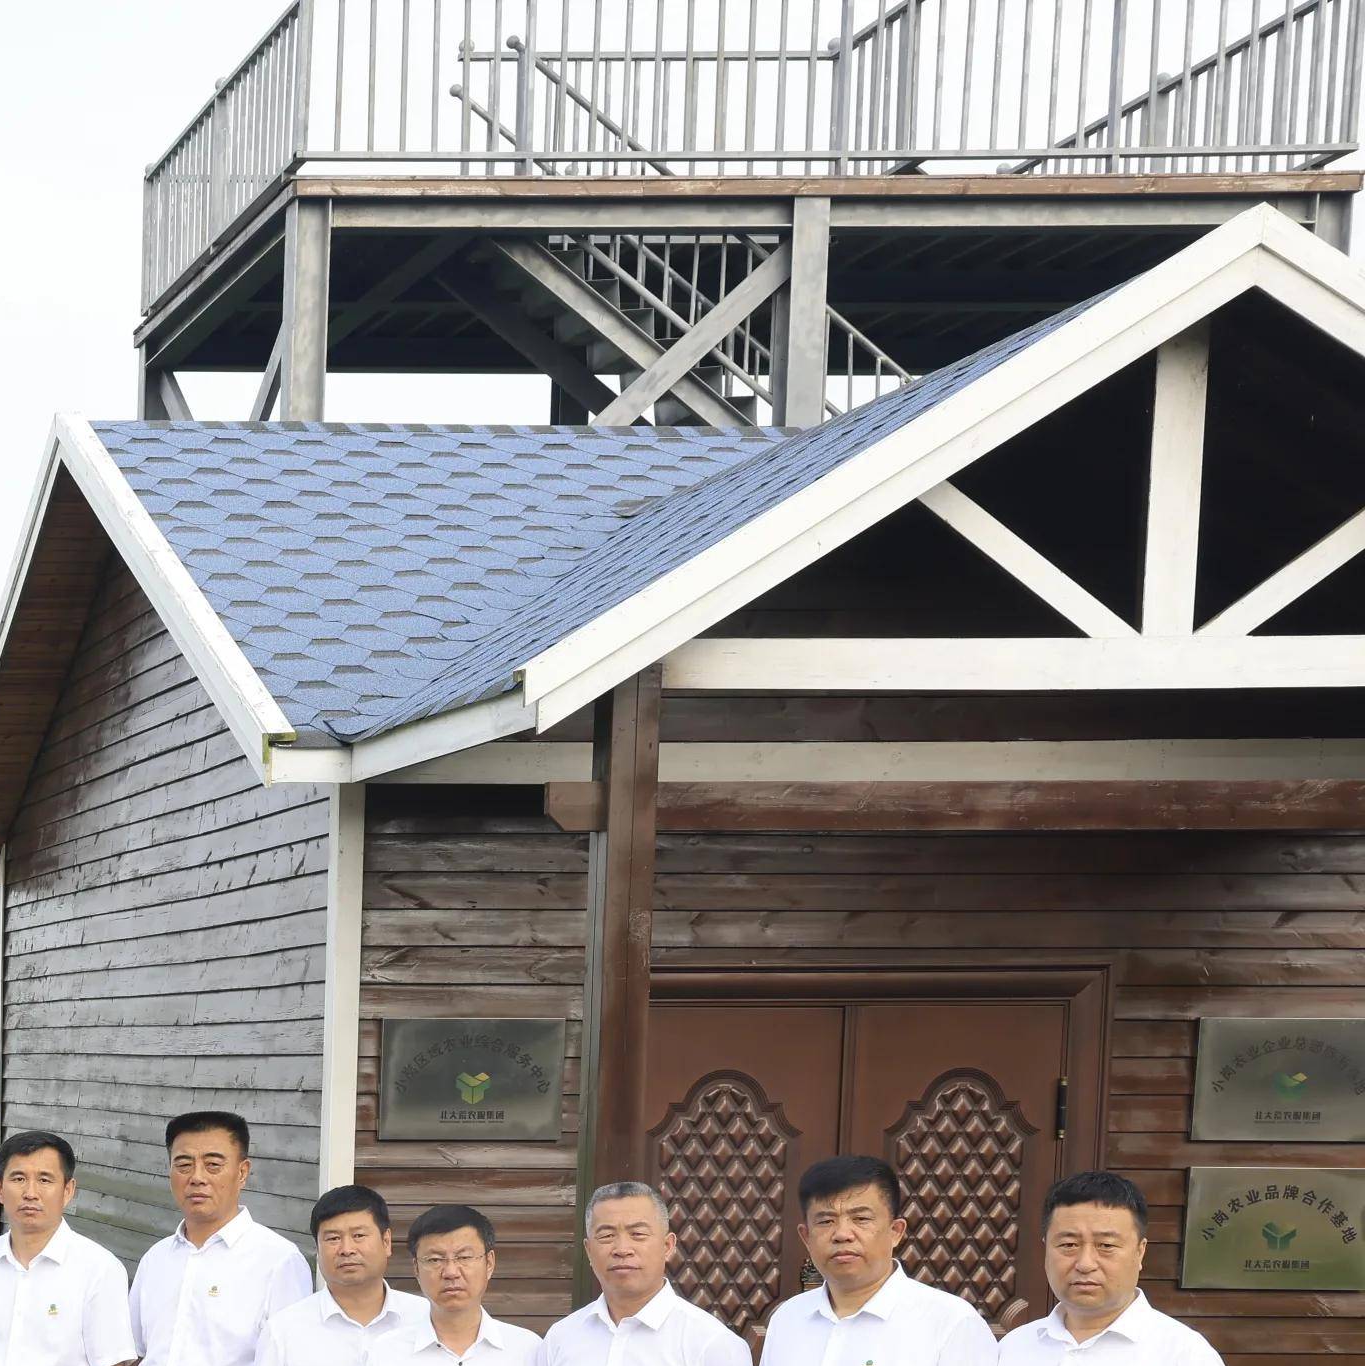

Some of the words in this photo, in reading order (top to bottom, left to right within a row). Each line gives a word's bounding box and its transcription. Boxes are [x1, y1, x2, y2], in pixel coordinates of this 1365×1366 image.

[1201, 1184, 1357, 1244] 小岗农业品牌合作基地
